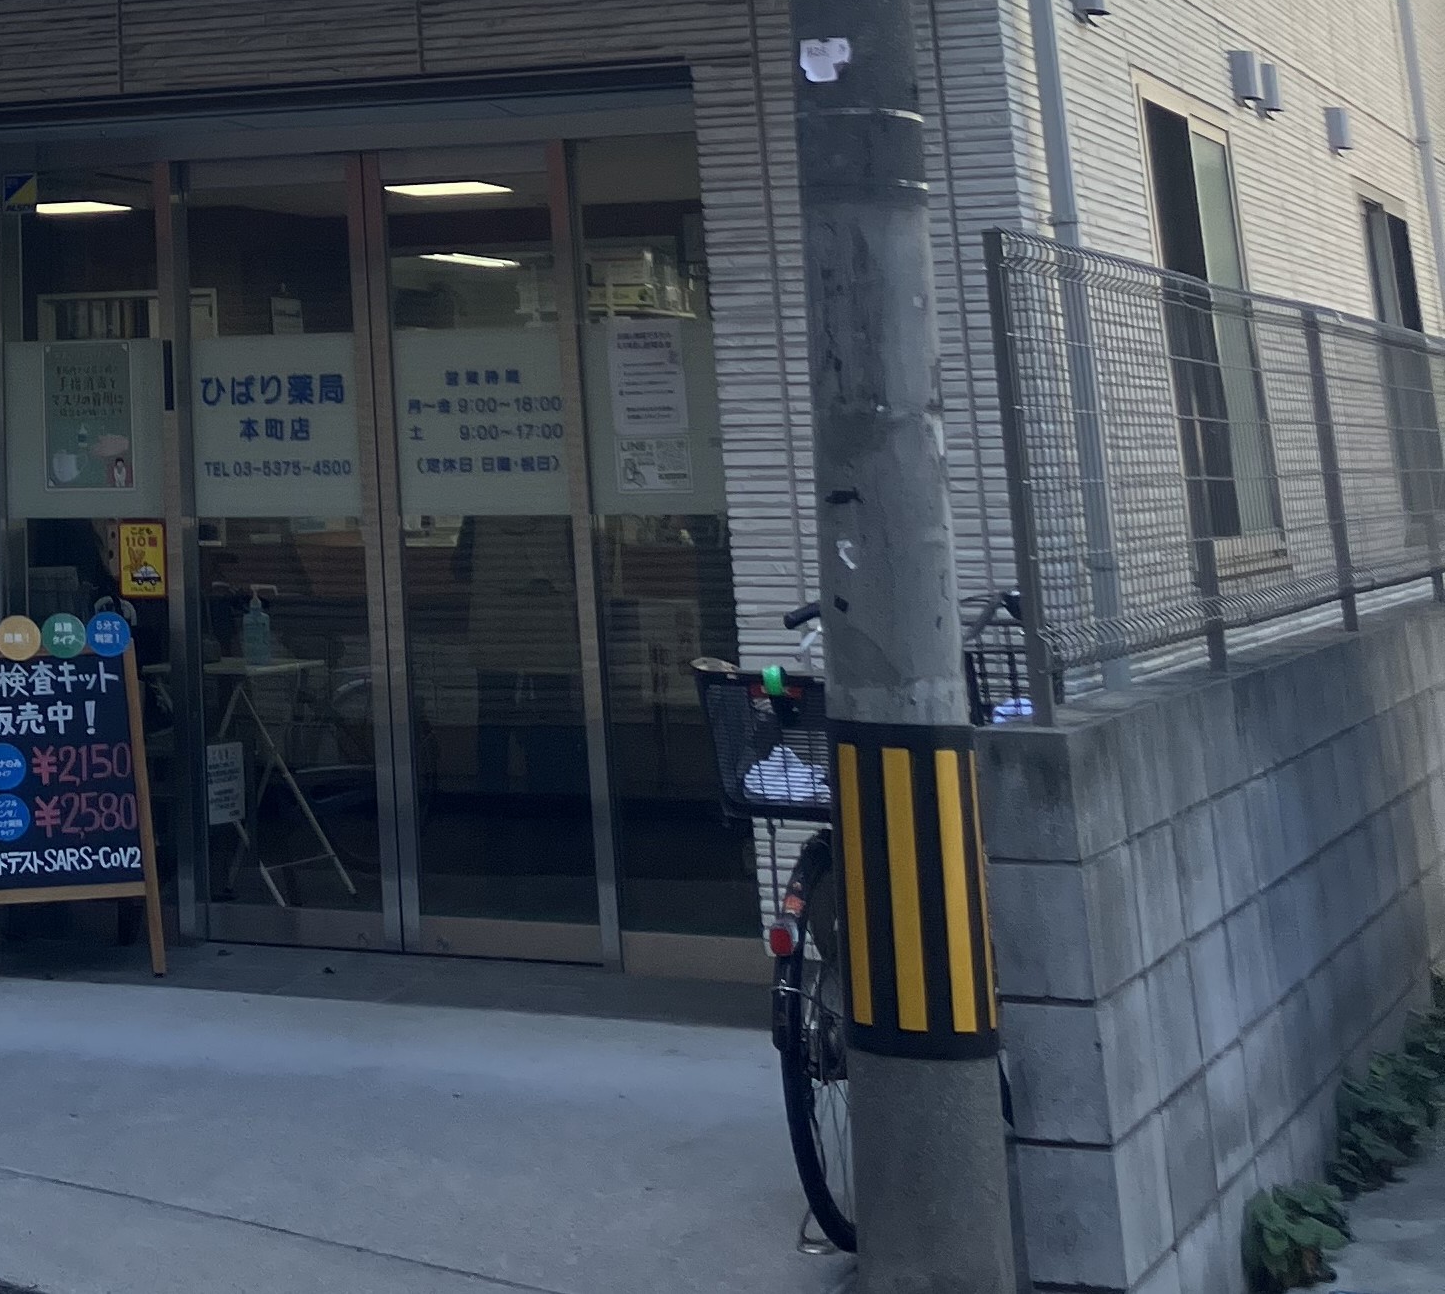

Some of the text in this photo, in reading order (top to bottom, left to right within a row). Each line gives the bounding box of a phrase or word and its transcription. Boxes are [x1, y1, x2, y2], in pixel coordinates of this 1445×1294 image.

[445, 369, 521, 386] 営業時間
[200, 373, 345, 406] ひばり薬局
[239, 417, 310, 442] 本町店
[410, 425, 425, 440] 土
[205, 459, 352, 477] TEL 03-5375-4500
[96, 620, 121, 632] 5分で
[53, 634, 77, 645] タイプ
